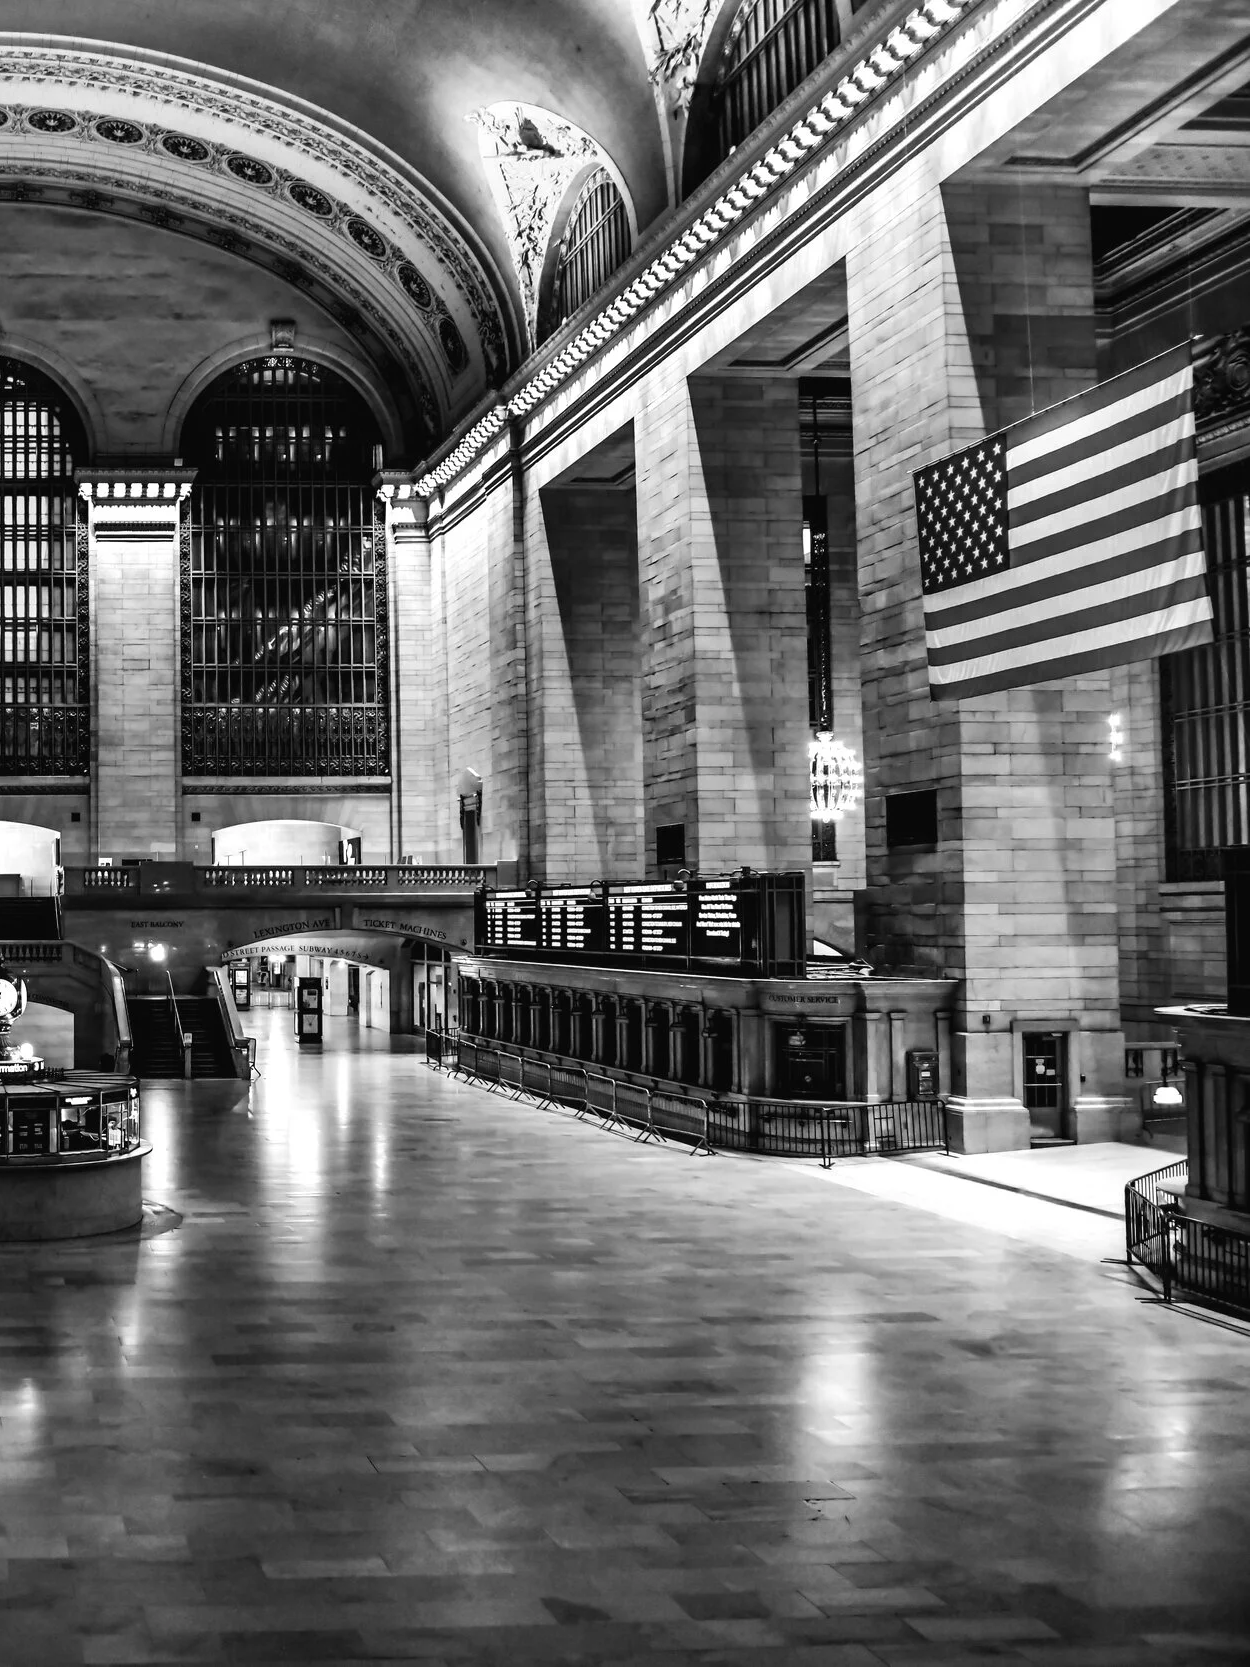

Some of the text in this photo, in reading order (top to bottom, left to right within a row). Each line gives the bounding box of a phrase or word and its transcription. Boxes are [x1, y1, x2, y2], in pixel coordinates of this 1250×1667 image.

[253, 919, 331, 939] LEXINGTON AVE
[364, 919, 447, 940] TICKET MACHINES
[230, 947, 259, 957] STREET
[299, 946, 333, 954] SUBWAY
[769, 994, 838, 1004] CUSTOMER SERVICE
